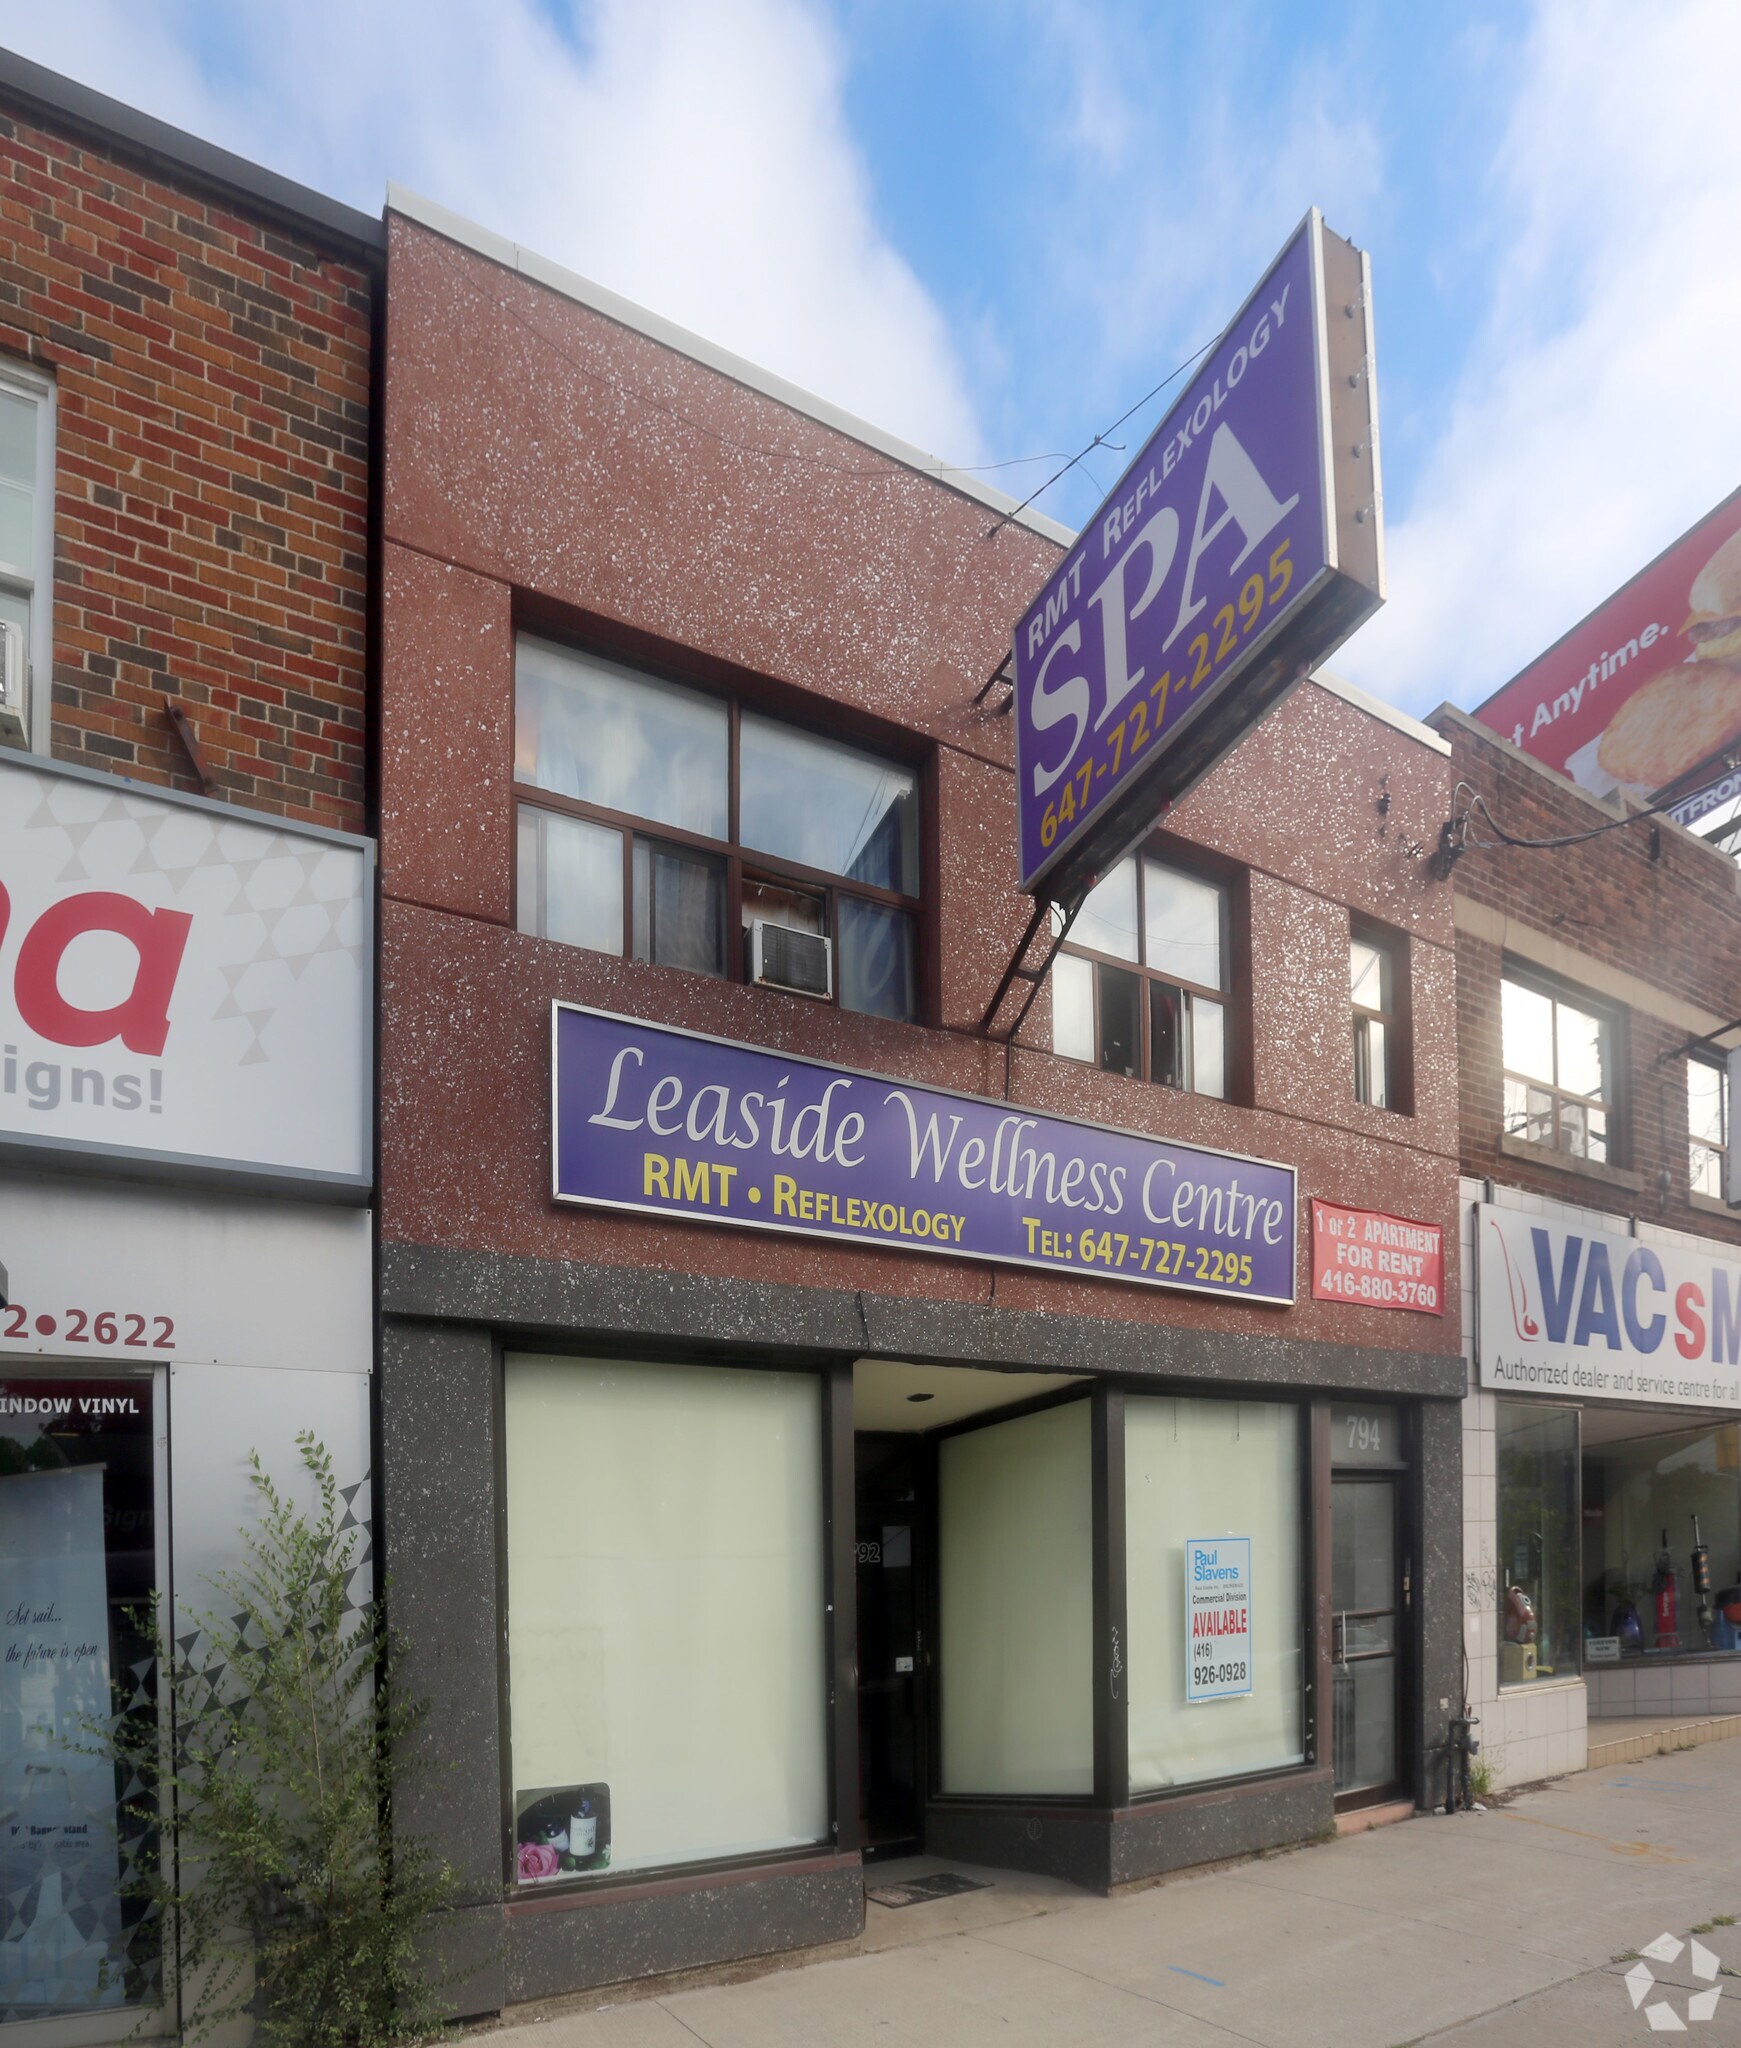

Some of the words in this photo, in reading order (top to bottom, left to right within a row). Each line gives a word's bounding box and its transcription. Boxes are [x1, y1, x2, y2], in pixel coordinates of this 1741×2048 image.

[1027, 550, 1086, 660] RMT
[1030, 421, 1299, 796] SPA
[1041, 538, 1294, 848] 647-727-2295
[1529, 621, 1669, 738] Anytime.
[0, 880, 194, 1057] a
[3, 1044, 163, 1114] igns!
[587, 1046, 865, 1168] Leaside
[884, 1090, 1127, 1215] Wellness
[1142, 1158, 1284, 1246] Centre
[643, 1153, 738, 1207] RMT
[1079, 1229, 1253, 1287] 647-727-2295
[1316, 1208, 1324, 1233] 1
[1329, 1217, 1343, 1236] or
[1347, 1216, 1356, 1239] 2
[1364, 1219, 1440, 1255] APARTMENT
[1337, 1242, 1374, 1270] FOR
[1378, 1250, 1424, 1277] RENT
[1321, 1269, 1437, 1307] 416-880-3760
[1494, 1354, 1569, 1386] Authorized
[1572, 1363, 1610, 1390] dealer
[1613, 1370, 1634, 1392] and
[1637, 1374, 1675, 1395] service
[1677, 1377, 1710, 1399] centre
[1712, 1378, 1727, 1400] for
[78, 1397, 139, 1414] VINYL
[1346, 1415, 1381, 1451] 794
[1193, 1565, 1239, 1582] Slavens
[1194, 1549, 1218, 1567] Paul
[1192, 1593, 1225, 1604] Commercial
[1226, 1592, 1247, 1602] Division
[1193, 1609, 1248, 1638] AVAILABLE
[5, 1645, 21, 1664] the
[23, 1642, 56, 1669] future
[60, 1642, 69, 1659] is
[74, 1641, 98, 1664] open
[1193, 1642, 1213, 1662] (416)
[1194, 1662, 1247, 1686] 926-0928
